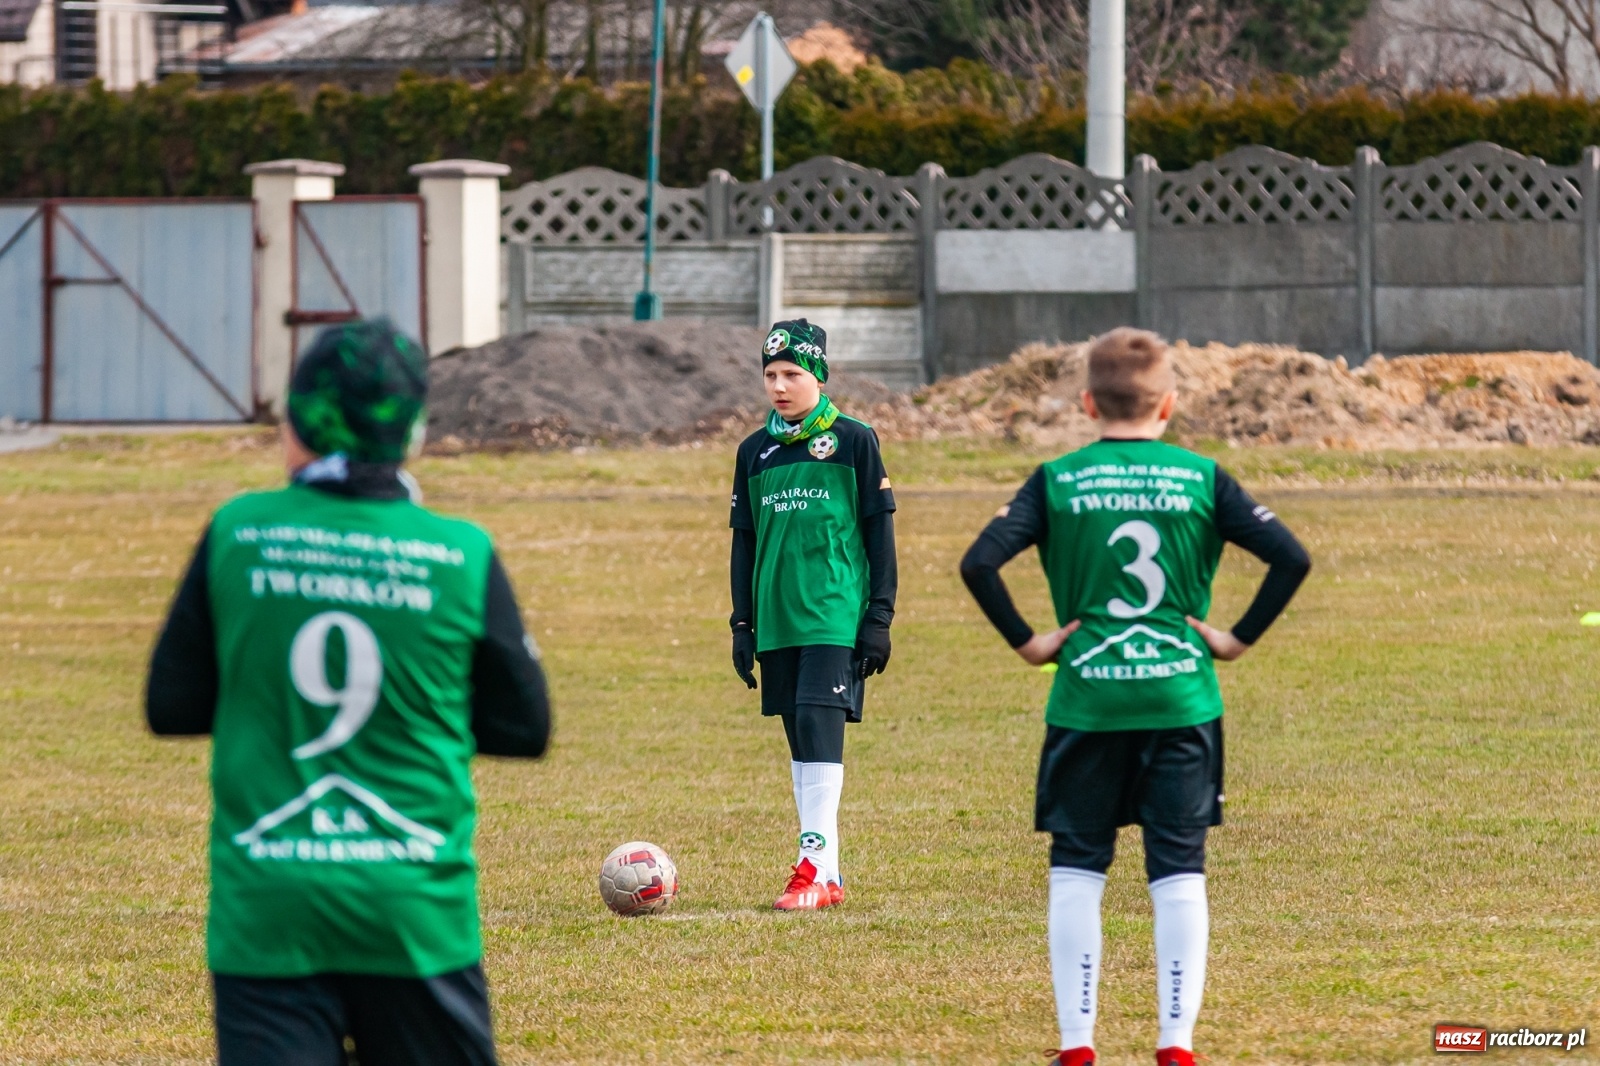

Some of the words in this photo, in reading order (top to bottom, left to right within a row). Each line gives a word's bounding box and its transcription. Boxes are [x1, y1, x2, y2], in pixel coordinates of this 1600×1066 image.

[1069, 490, 1193, 515] TWORKÓW
[1106, 519, 1167, 619] 3
[289, 610, 383, 761] 9
